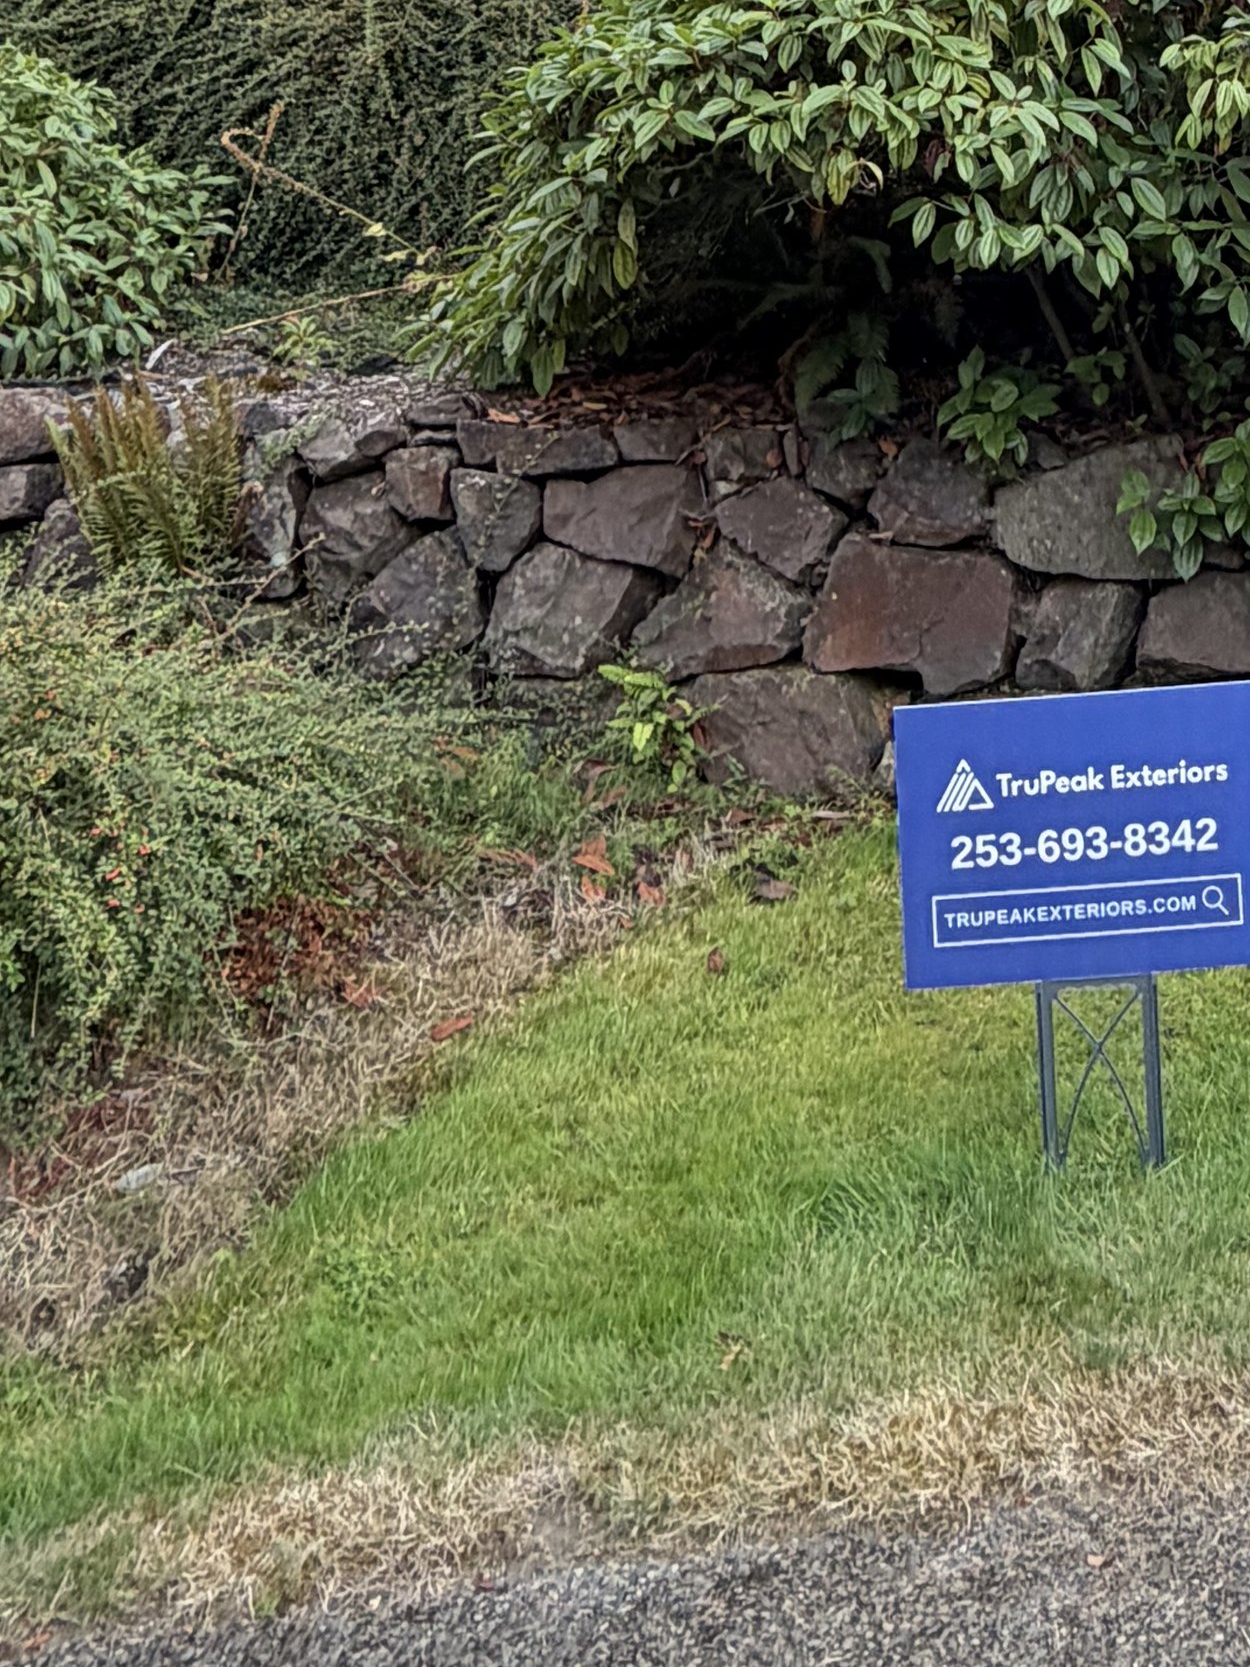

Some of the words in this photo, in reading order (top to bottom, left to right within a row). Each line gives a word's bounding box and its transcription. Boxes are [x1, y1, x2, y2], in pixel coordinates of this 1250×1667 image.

[996, 767, 1104, 797] TruPeak
[1111, 760, 1228, 789] Exteriors
[951, 818, 1218, 869] 253-693-8342
[944, 896, 1196, 928] TRUPEAKEXTERIORS.COM
